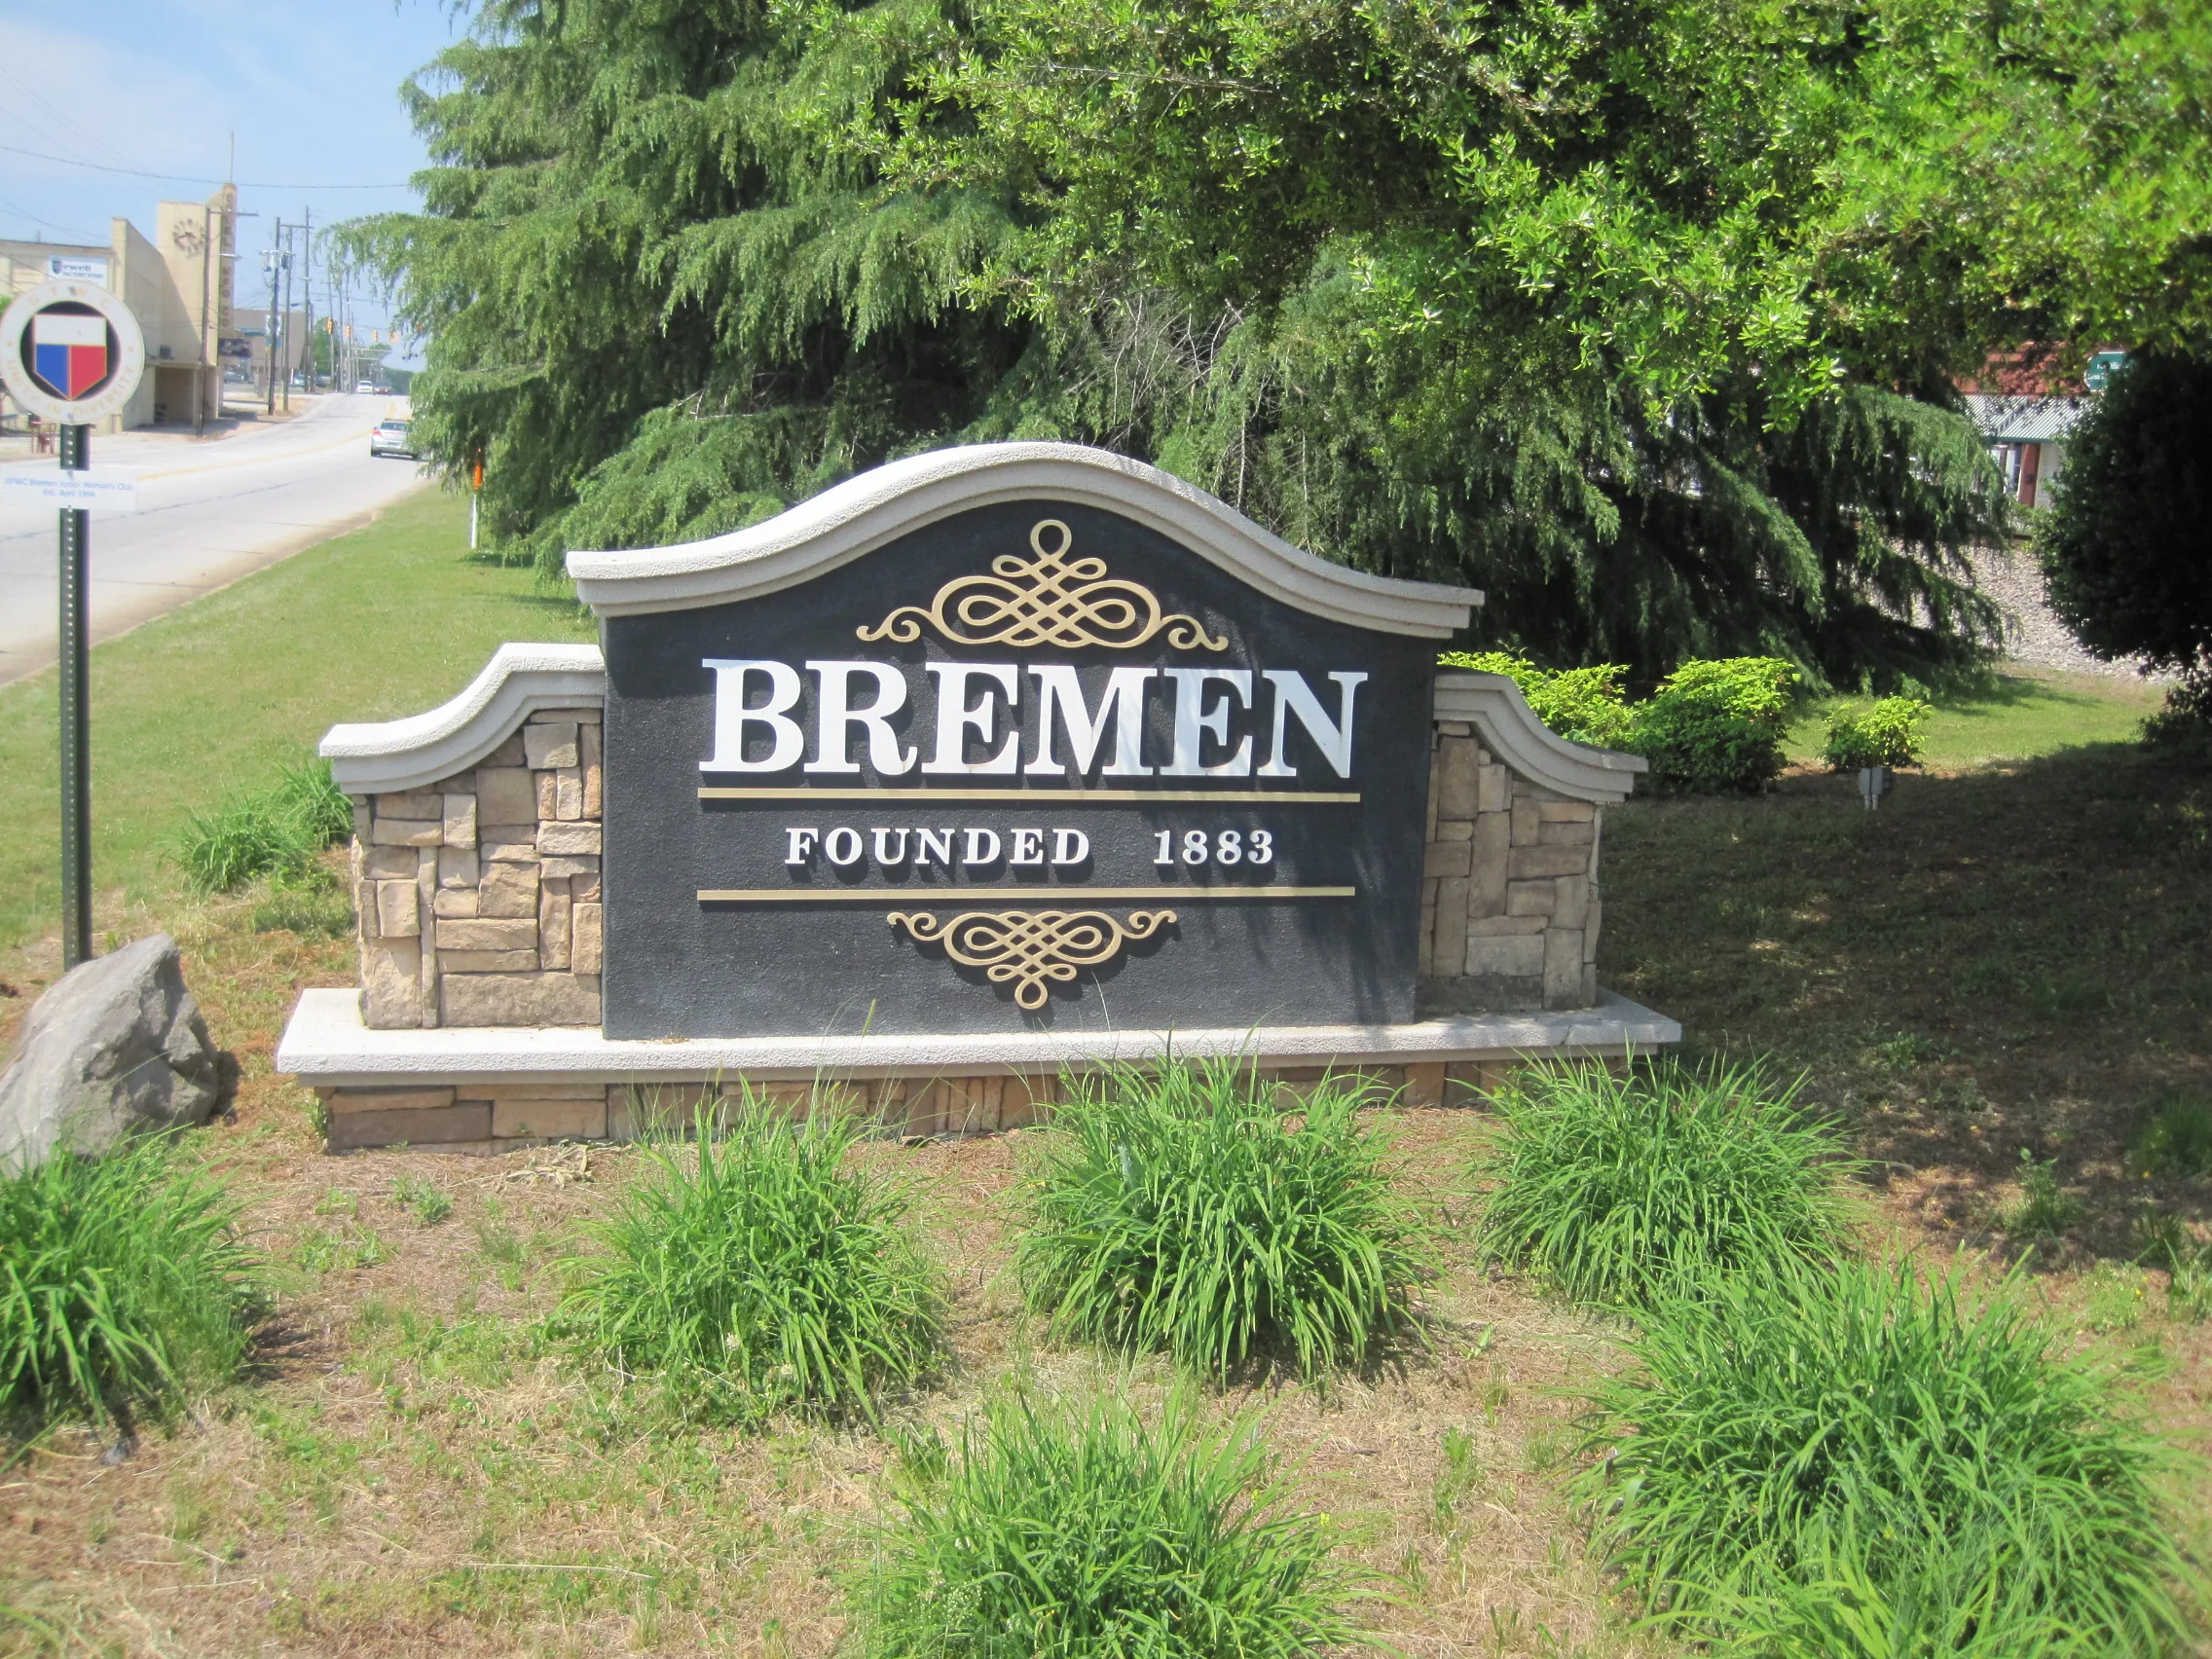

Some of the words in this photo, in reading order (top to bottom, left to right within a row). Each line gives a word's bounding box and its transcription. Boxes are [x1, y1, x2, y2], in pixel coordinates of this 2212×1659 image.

[698, 658, 1368, 779] BREMEN
[784, 827, 1090, 866] FOUNDED
[1153, 829, 1273, 866] 1883
